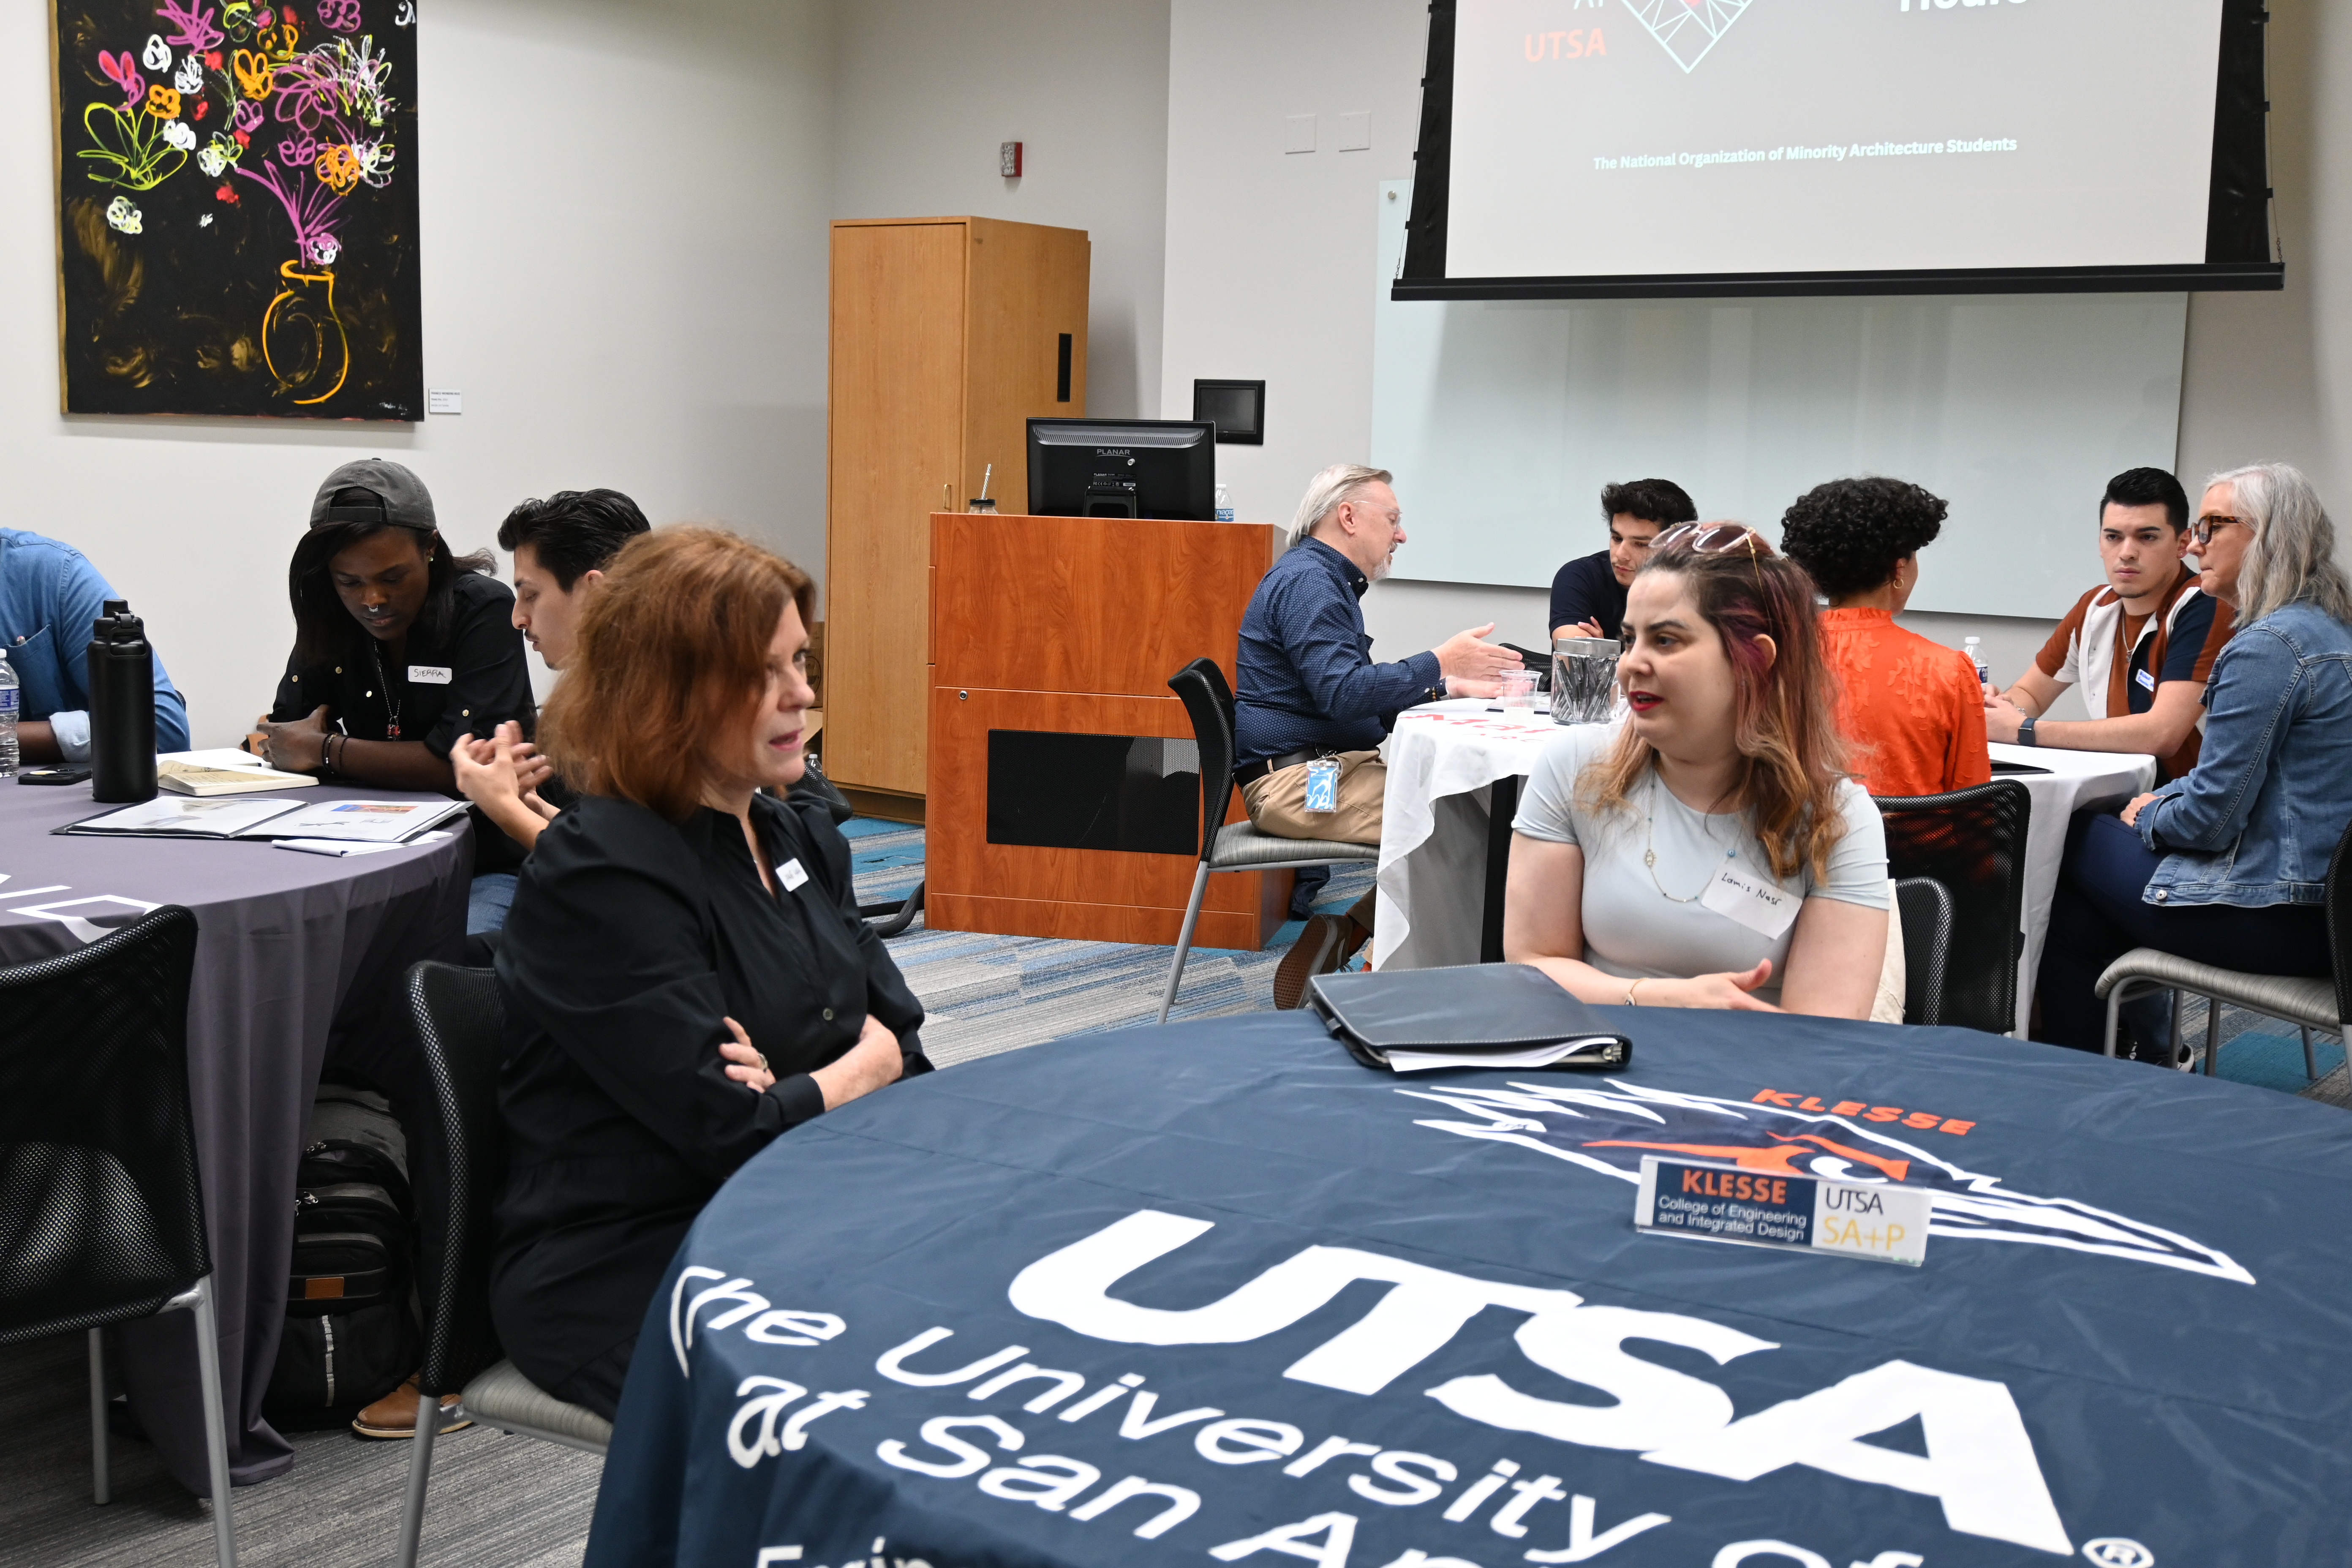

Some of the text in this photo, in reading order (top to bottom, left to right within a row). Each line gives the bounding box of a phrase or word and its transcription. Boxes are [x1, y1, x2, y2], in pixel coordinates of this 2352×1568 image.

[1525, 27, 1606, 62] UTSA
[1594, 138, 2017, 170] The National Organization of Minority Architecture Students
[414, 669, 446, 678] SIERRA
[1721, 872, 1751, 892] Lamis
[1753, 1089, 1976, 1135] KLESSE
[1682, 1169, 1787, 1204] KLESSE
[1825, 1187, 1884, 1215] UTSA
[1658, 1195, 1807, 1229] College of Engineering
[1658, 1211, 1804, 1242] and Integrated Design
[1822, 1216, 1905, 1251] SA+P
[1008, 1210, 2074, 1555] UTSA
[727, 1375, 1200, 1539] at San
[876, 1326, 1671, 1564] University
